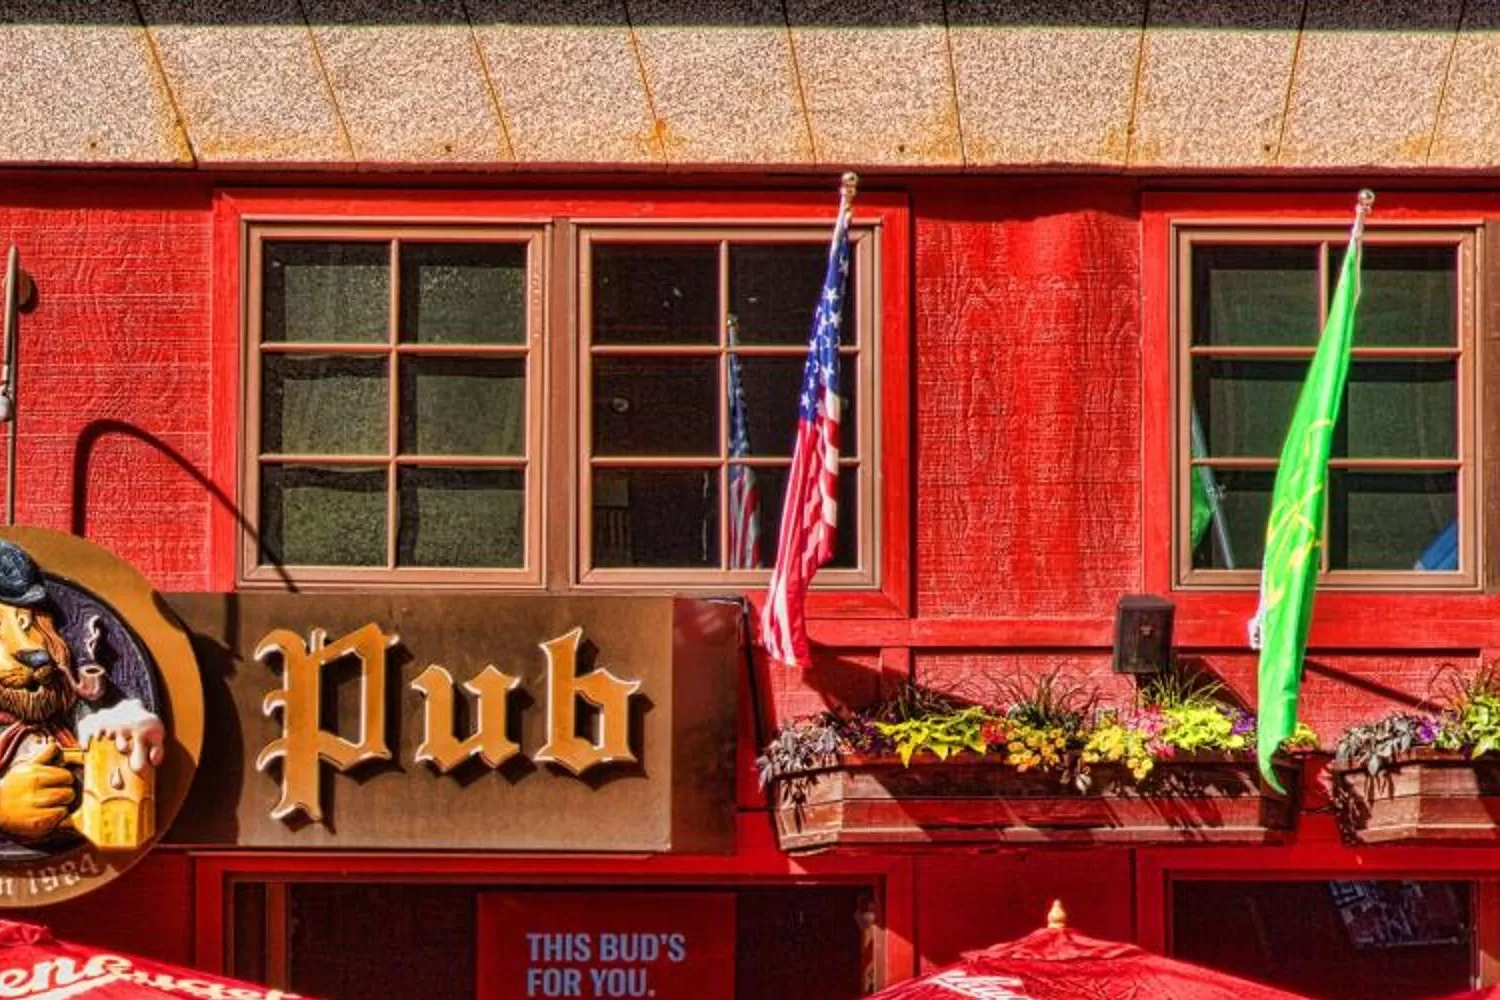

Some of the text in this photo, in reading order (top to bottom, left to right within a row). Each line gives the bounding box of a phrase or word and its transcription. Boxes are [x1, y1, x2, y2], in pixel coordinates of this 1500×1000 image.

[254, 622, 642, 821] Pub
[526, 933, 686, 962] THIS BUD'S
[527, 968, 656, 997] FOR YOU.
